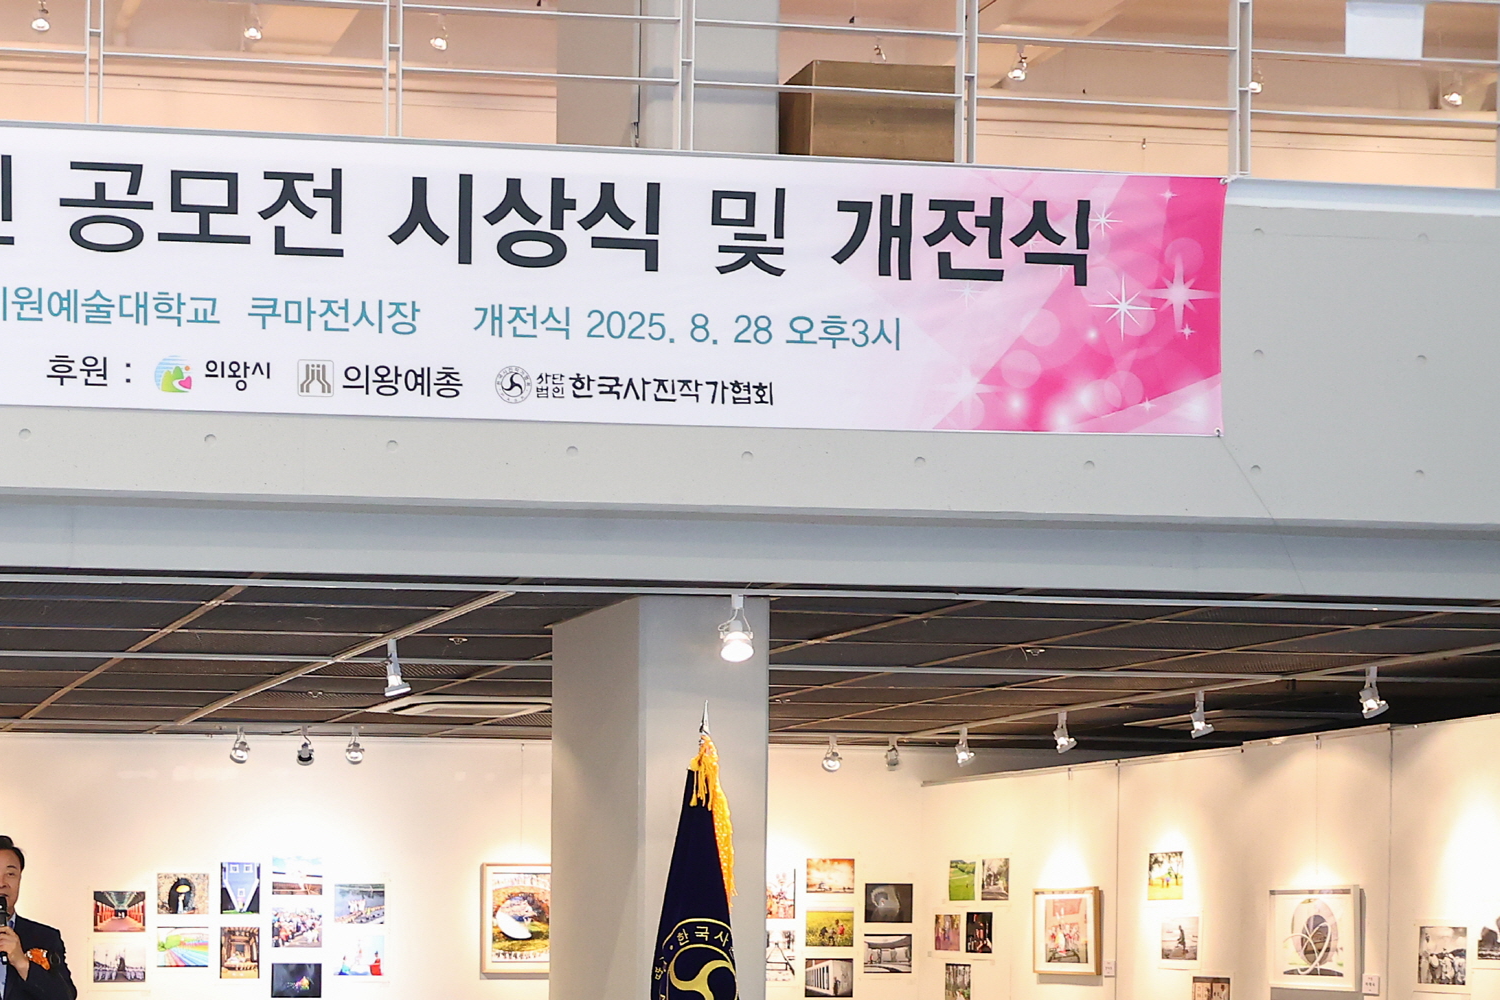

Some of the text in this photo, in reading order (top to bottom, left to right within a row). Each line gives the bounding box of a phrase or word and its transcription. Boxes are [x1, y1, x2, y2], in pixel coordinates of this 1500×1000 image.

[59, 160, 344, 258] 공모전
[387, 173, 661, 272] 시상식
[711, 187, 786, 276] 및
[831, 191, 1091, 287] 개전식
[247, 296, 421, 336] 쿠마전시장
[473, 303, 901, 352] 개전식 2025. 8. 28 오후3시
[46, 354, 108, 387] 후원
[204, 359, 271, 392] 의왕시
[342, 364, 463, 399] 의왕예총
[568, 372, 775, 406] 한국사진작가협회
